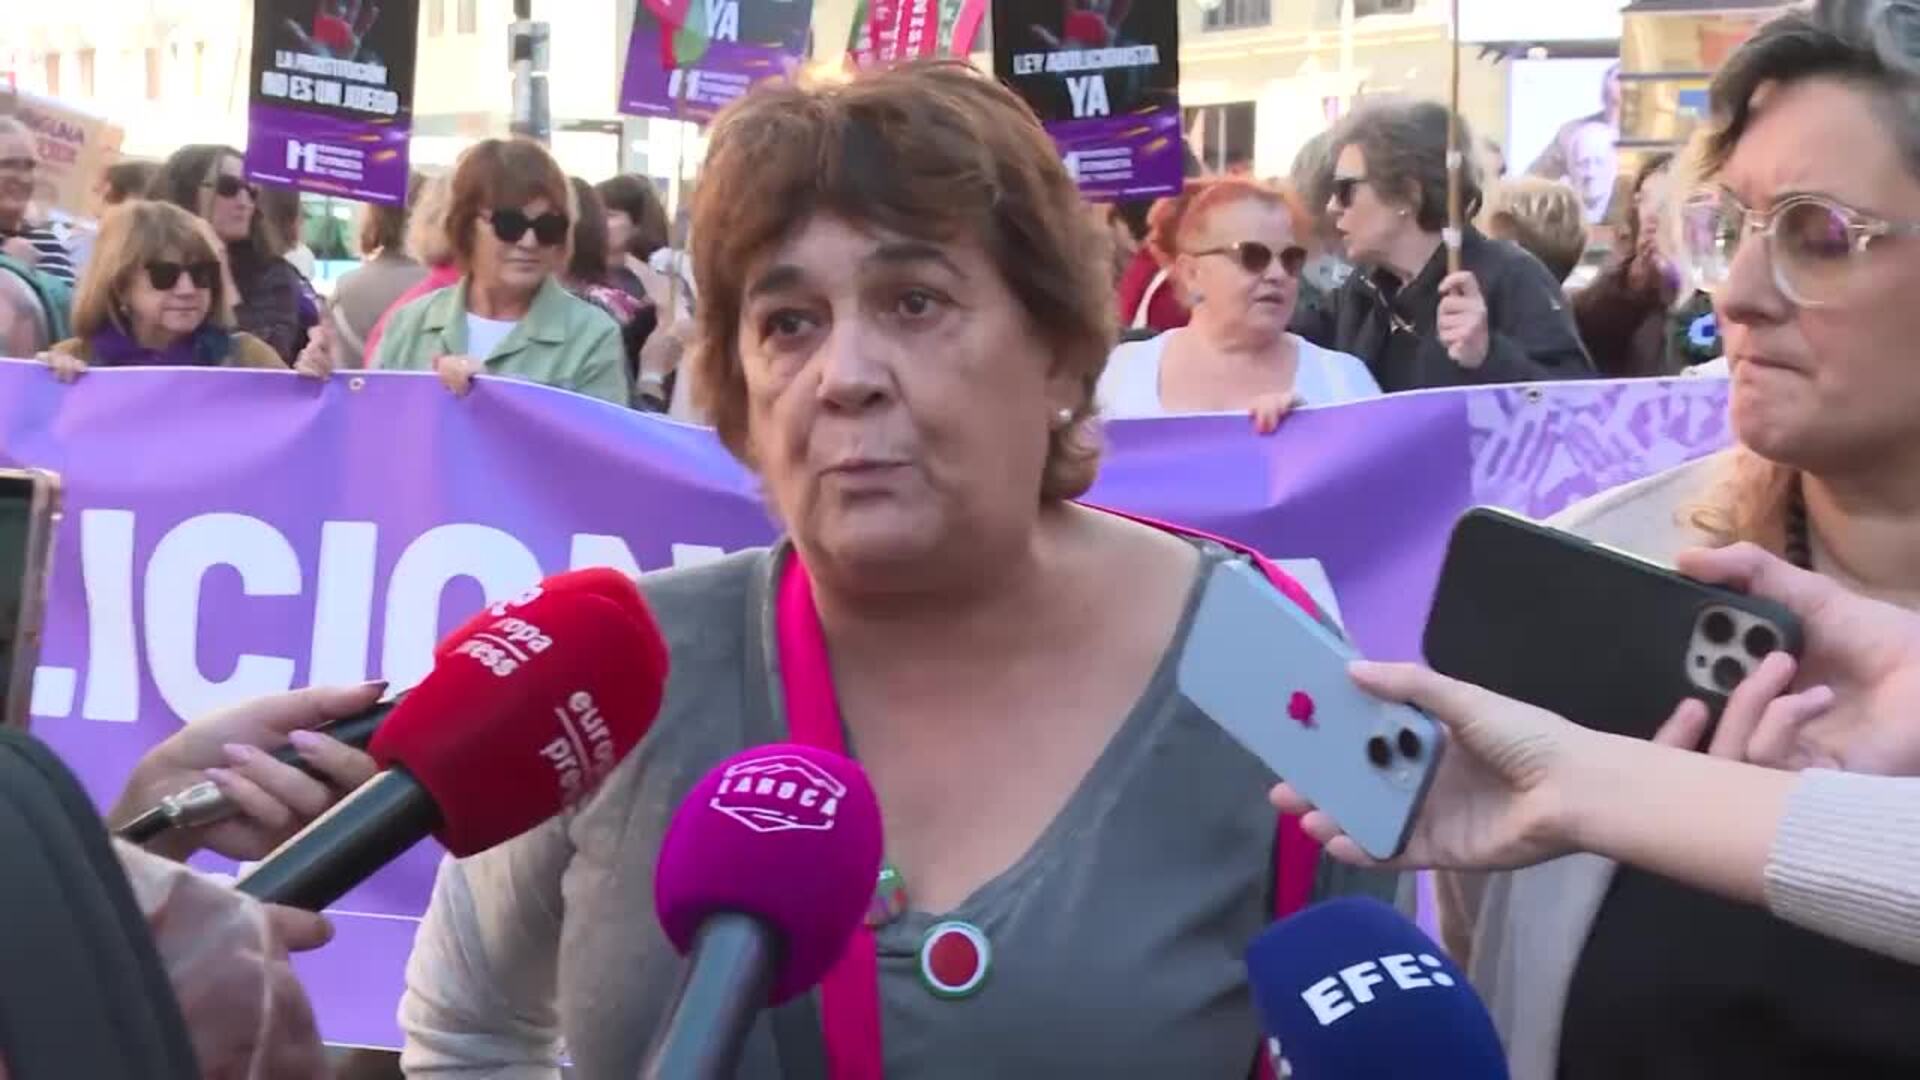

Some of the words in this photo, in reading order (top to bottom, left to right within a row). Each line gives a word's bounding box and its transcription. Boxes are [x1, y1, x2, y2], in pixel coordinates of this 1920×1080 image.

[703, 0, 740, 42] YA
[1013, 53, 1045, 75] LEY
[289, 74, 314, 102] ES
[1065, 75, 1110, 118] YA
